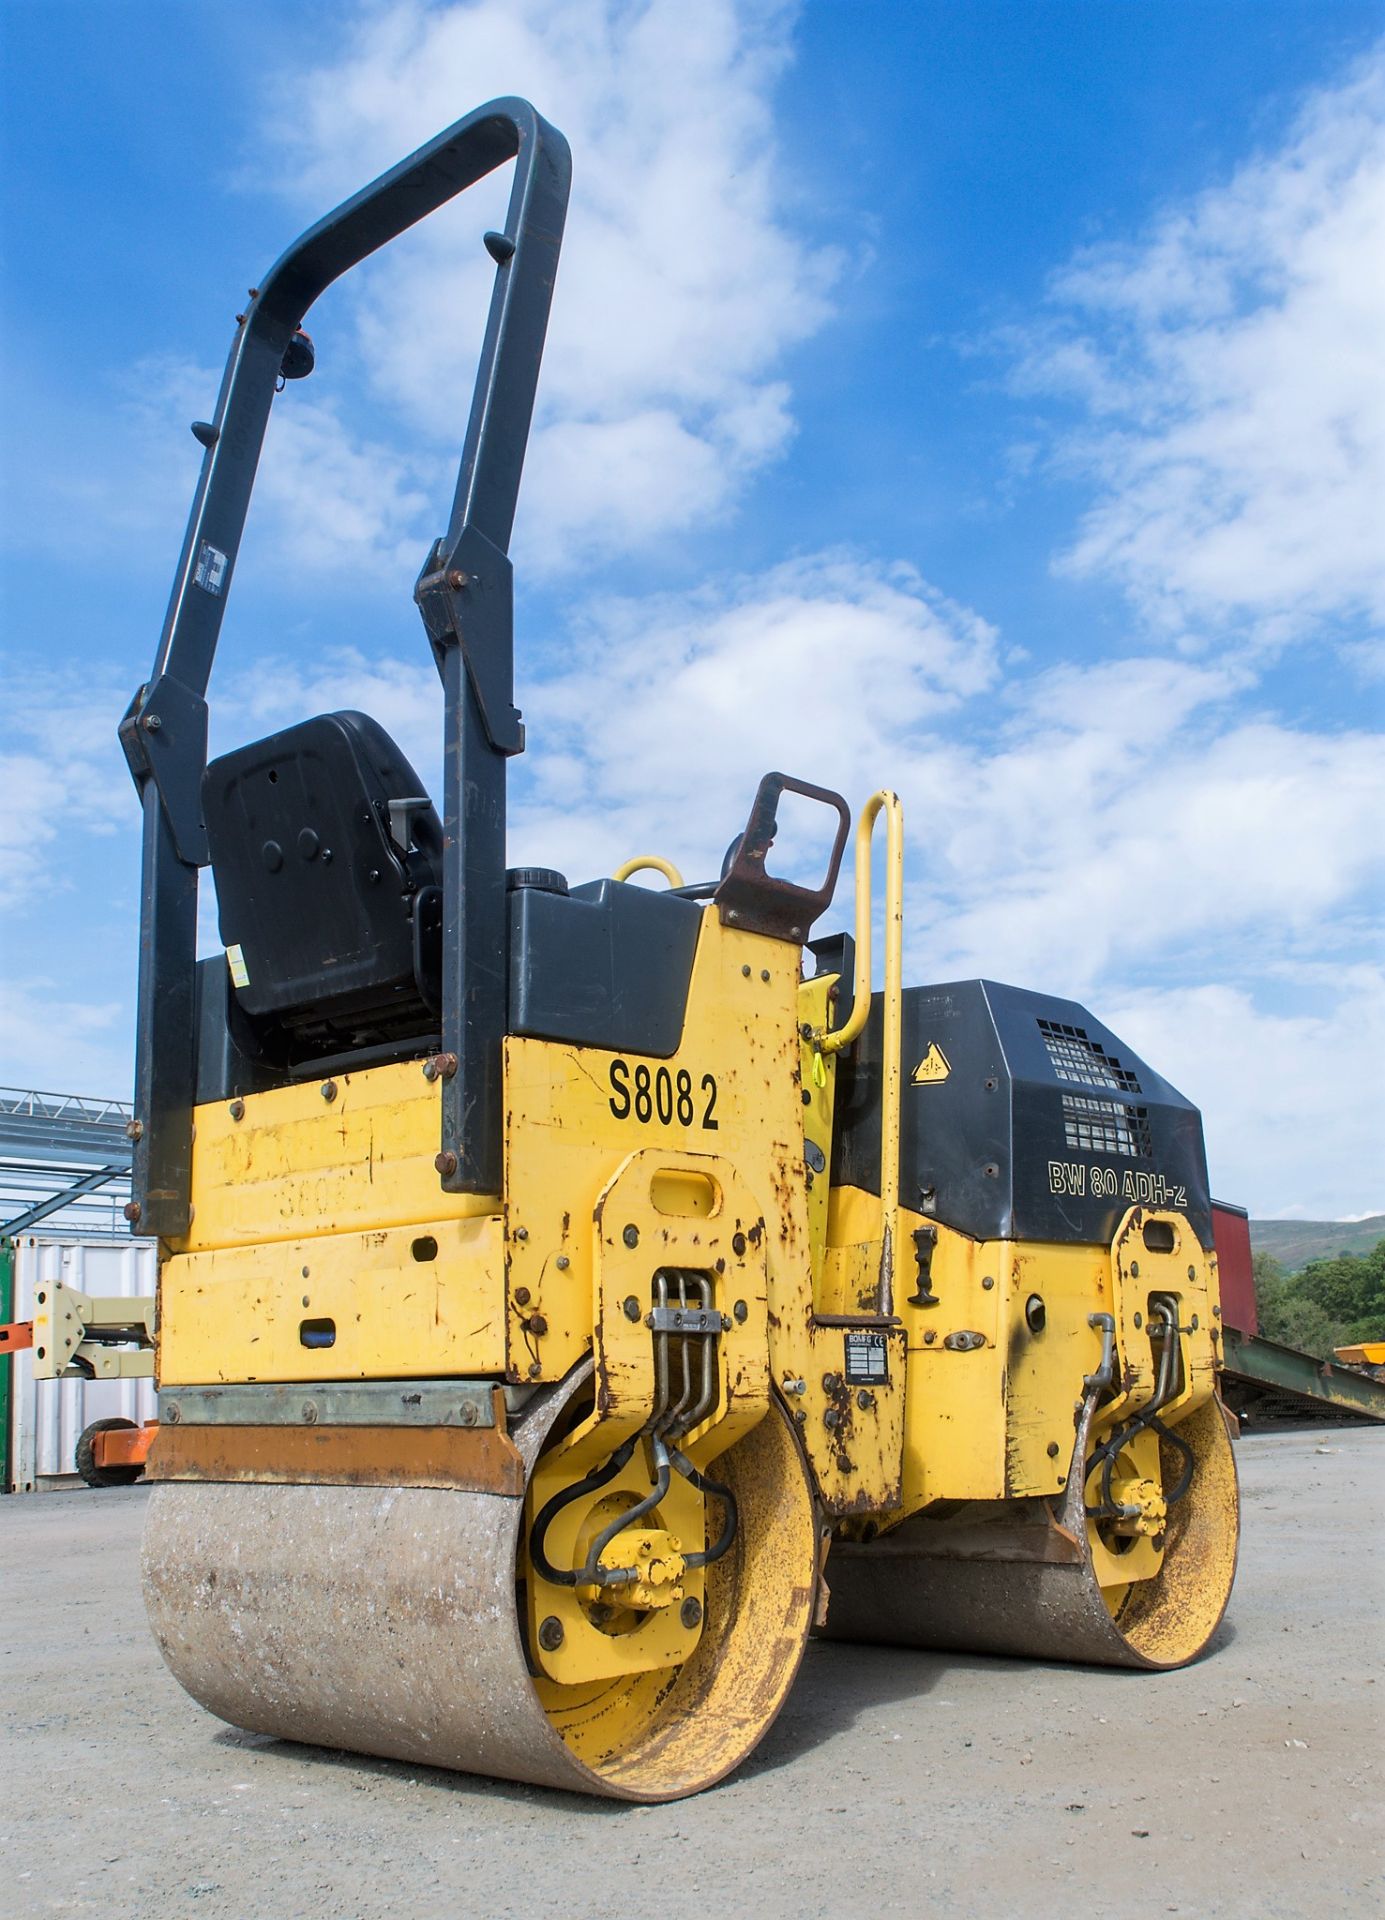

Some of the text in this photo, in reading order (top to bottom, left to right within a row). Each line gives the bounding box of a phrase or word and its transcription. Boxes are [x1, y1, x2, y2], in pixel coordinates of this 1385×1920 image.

[609, 1059, 718, 1130] S8082
[1048, 1161, 1188, 1207] BW 80 ADH-2
